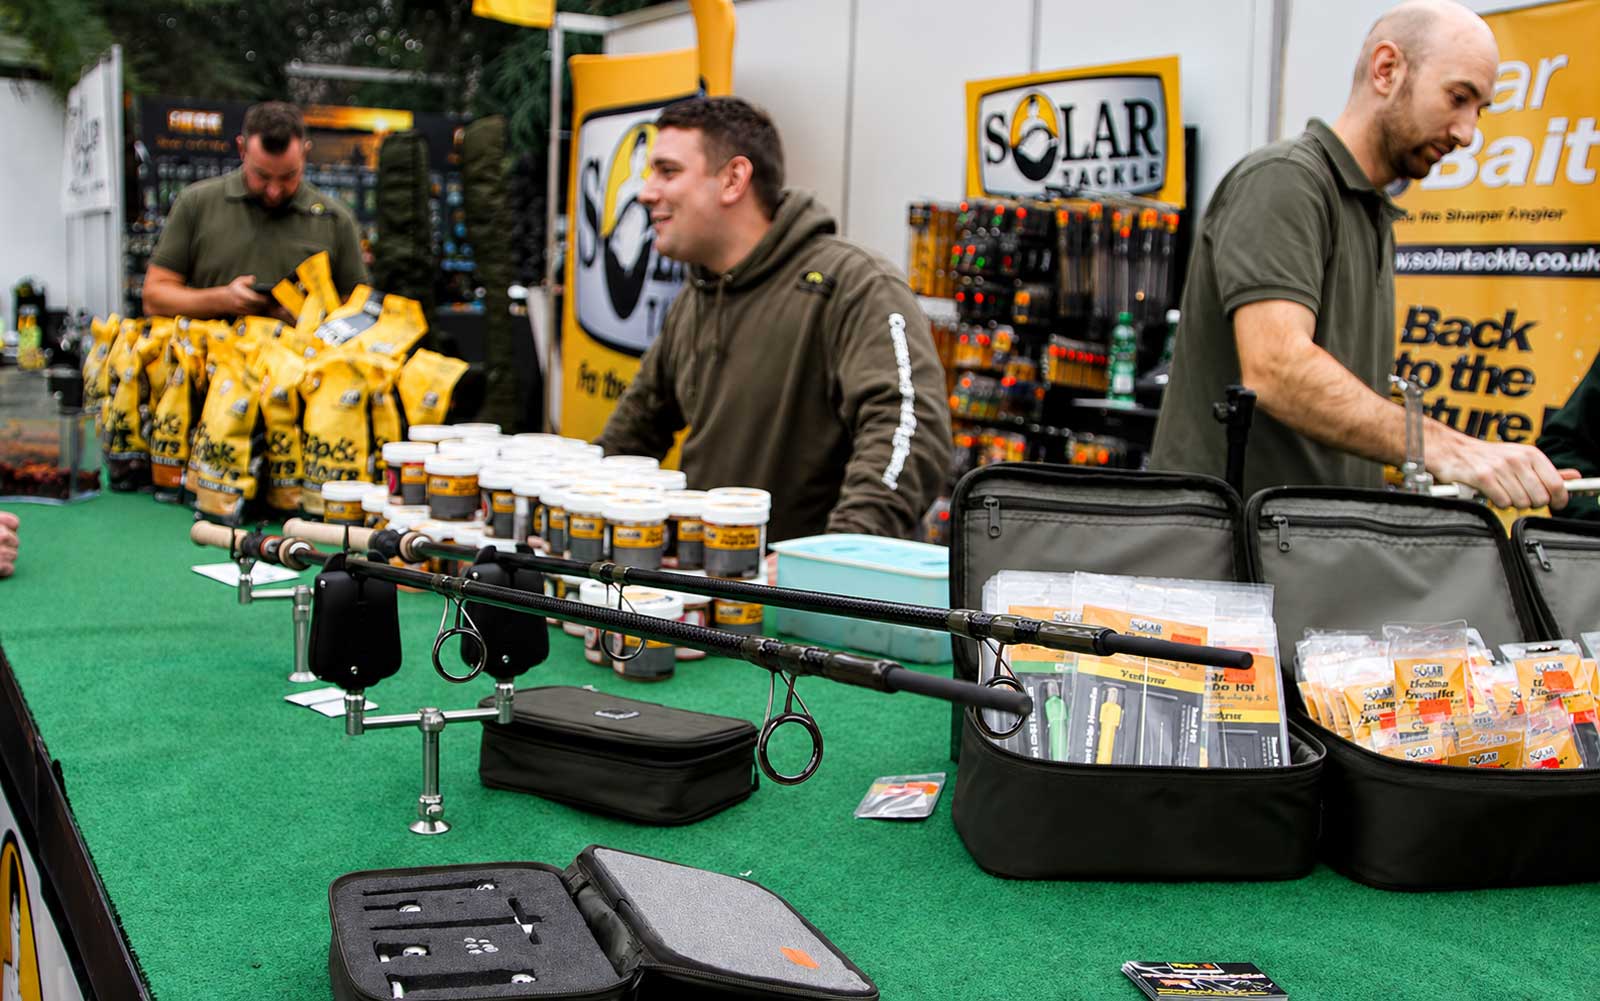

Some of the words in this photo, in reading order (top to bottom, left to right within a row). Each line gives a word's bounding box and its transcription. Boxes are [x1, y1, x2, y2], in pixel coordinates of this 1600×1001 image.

[1487, 54, 1568, 113] ar
[986, 92, 1160, 181] SOLAR
[1062, 161, 1160, 188] TACKLE
[1401, 305, 1537, 351] Back
[1395, 351, 1443, 391] to
[1451, 353, 1536, 397] the
[1423, 396, 1533, 443] ture
[1130, 620, 1162, 634] SOLAR
[1413, 665, 1443, 679] SOLAR
